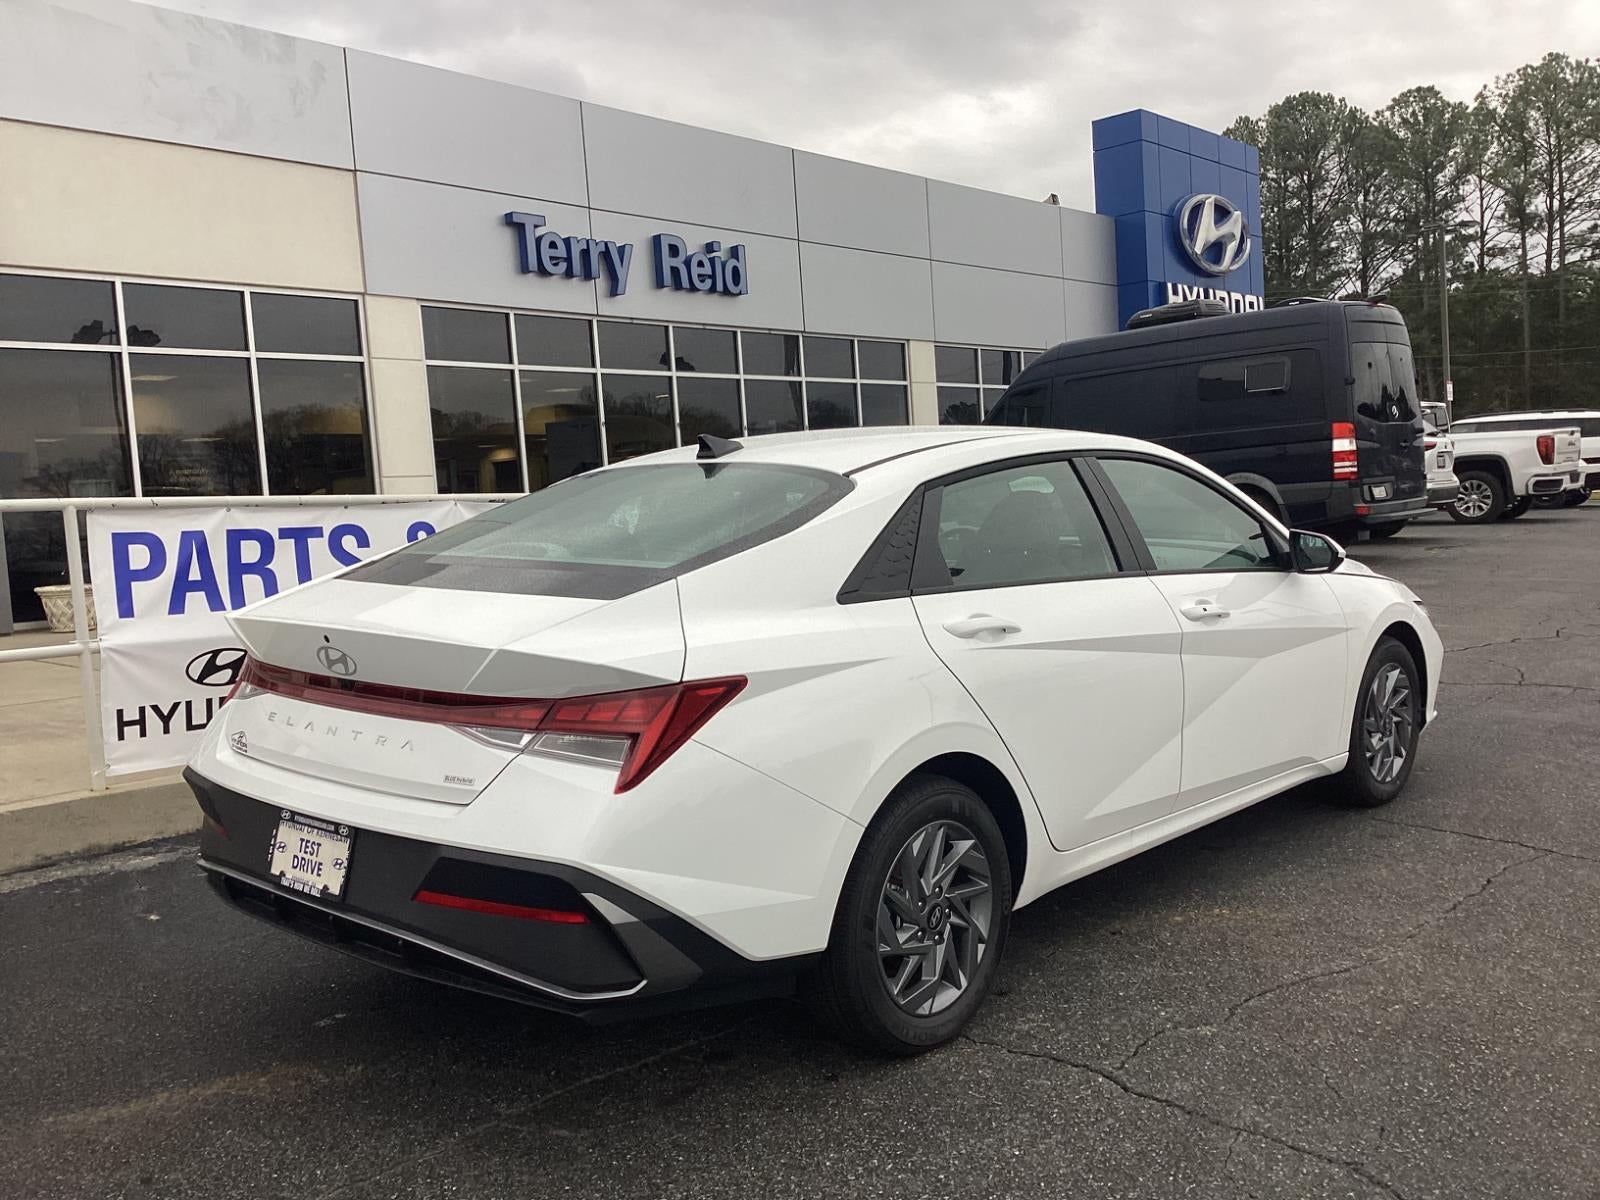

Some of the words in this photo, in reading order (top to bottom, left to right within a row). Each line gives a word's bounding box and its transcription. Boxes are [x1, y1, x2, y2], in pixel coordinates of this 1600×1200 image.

[504, 211, 633, 296] Terry
[650, 233, 748, 295] Reid
[115, 696, 227, 741] HYU
[267, 711, 415, 751] ELANTRA
[292, 854, 323, 877] DRIVE
[299, 838, 321, 857] TEST
